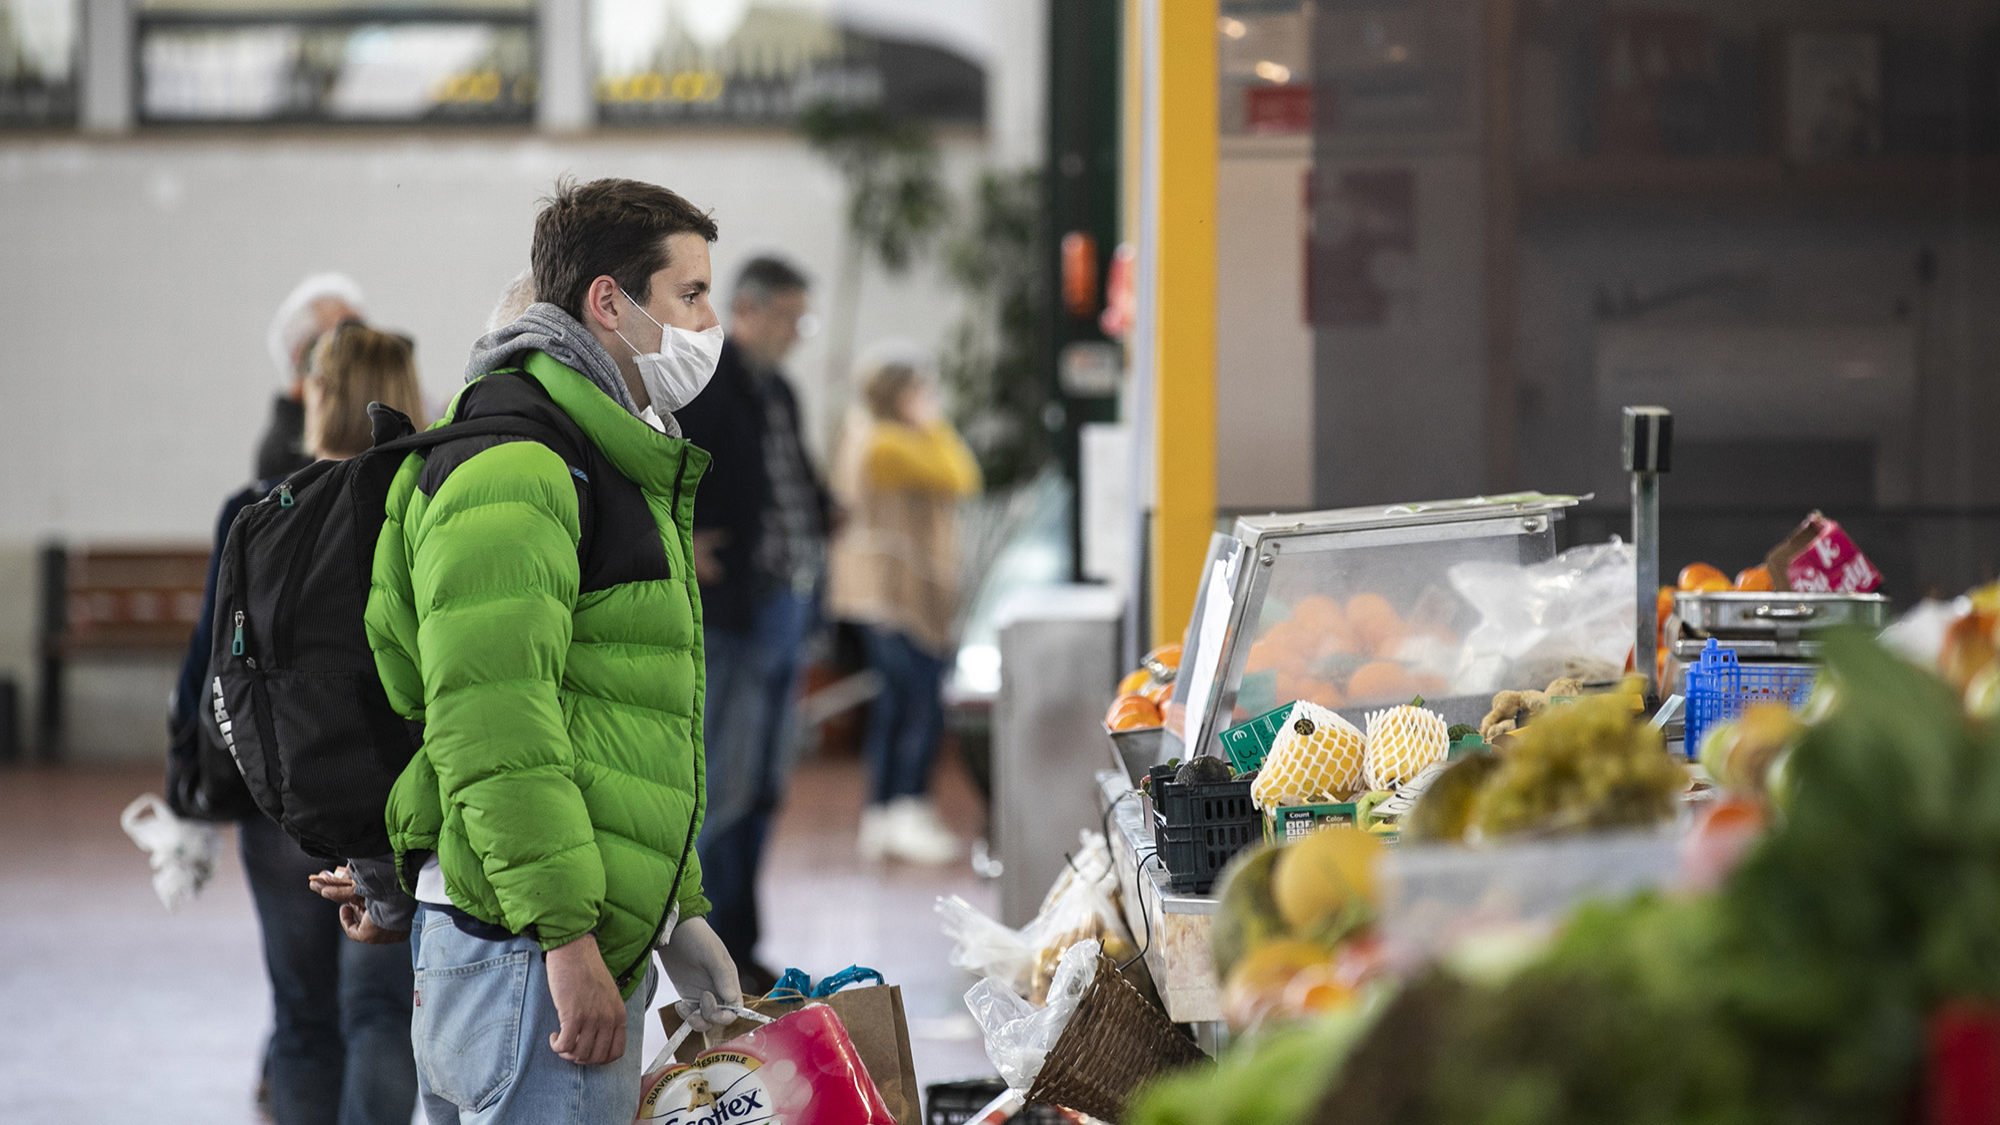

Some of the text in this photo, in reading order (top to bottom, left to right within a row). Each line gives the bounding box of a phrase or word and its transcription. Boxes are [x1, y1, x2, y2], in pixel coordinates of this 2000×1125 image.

[212, 676, 246, 776] THU
[1289, 811, 1310, 819] Count
[1326, 815, 1344, 823] Color
[646, 1069, 684, 1106] SUAVIDA
[664, 1090, 763, 1125] ttex
